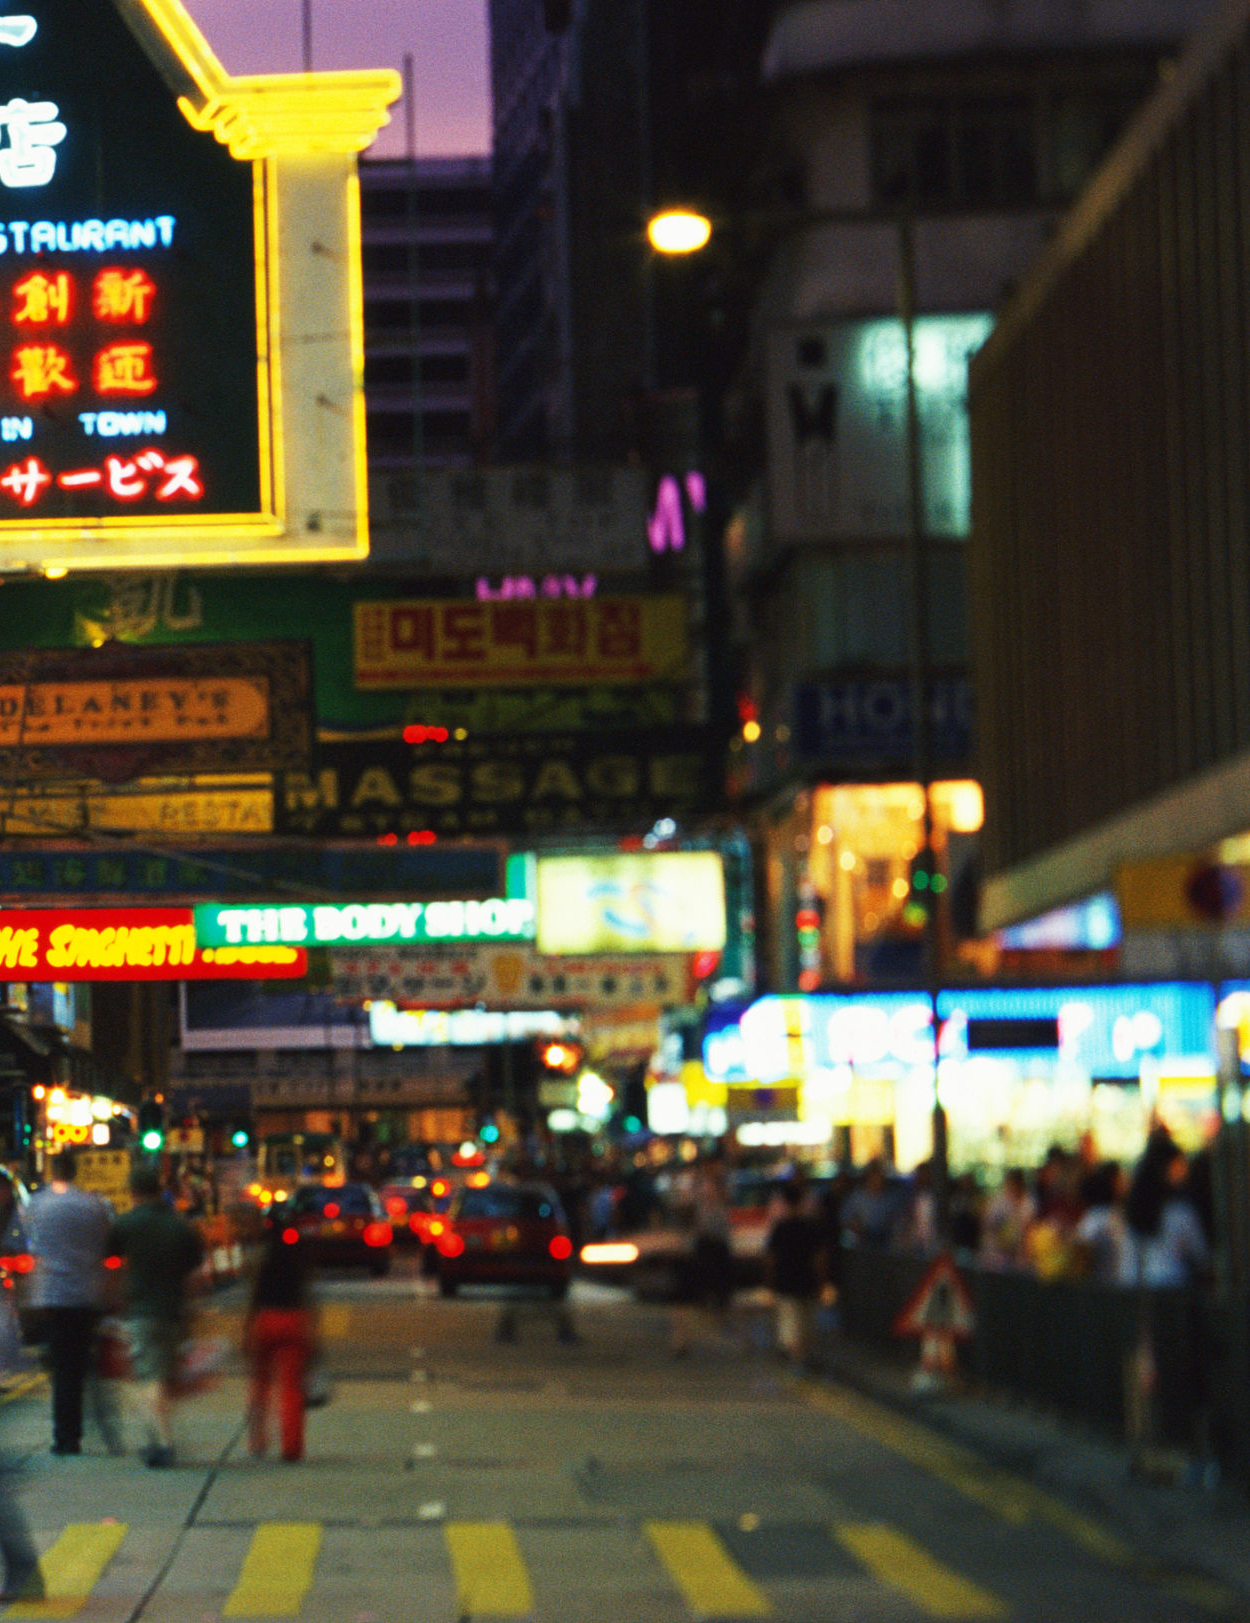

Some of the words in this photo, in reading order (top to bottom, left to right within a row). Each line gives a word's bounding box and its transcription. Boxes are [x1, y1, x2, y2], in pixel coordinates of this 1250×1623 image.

[1, 416, 34, 442] IN
[78, 410, 167, 437] TOWN
[217, 907, 309, 943] THE
[314, 903, 423, 940] BODY
[425, 898, 534, 938] SHOP
